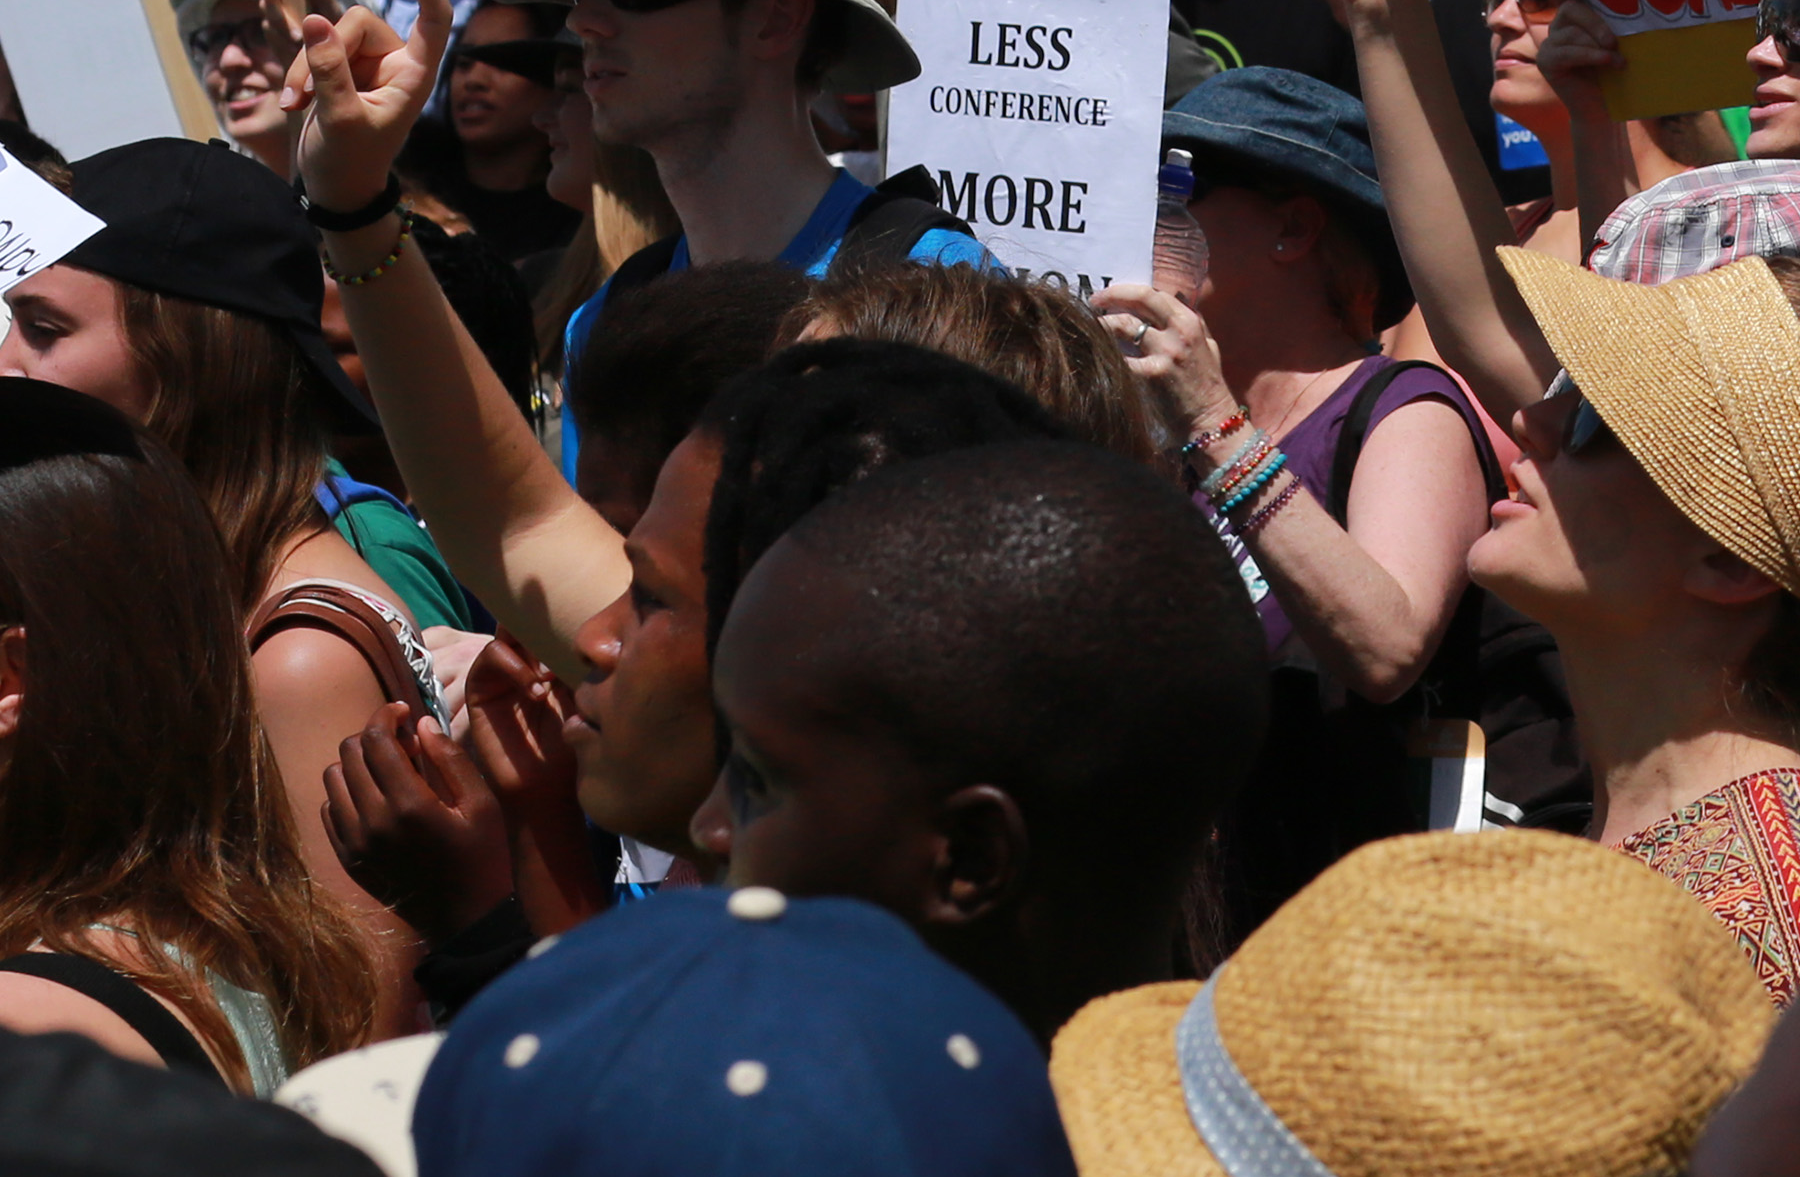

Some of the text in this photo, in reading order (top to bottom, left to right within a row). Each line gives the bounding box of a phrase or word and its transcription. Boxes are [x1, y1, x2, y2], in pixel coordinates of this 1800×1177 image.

[968, 21, 1073, 71] LESS
[929, 86, 1109, 127] CONFERENCE
[936, 169, 1089, 234] MORE
